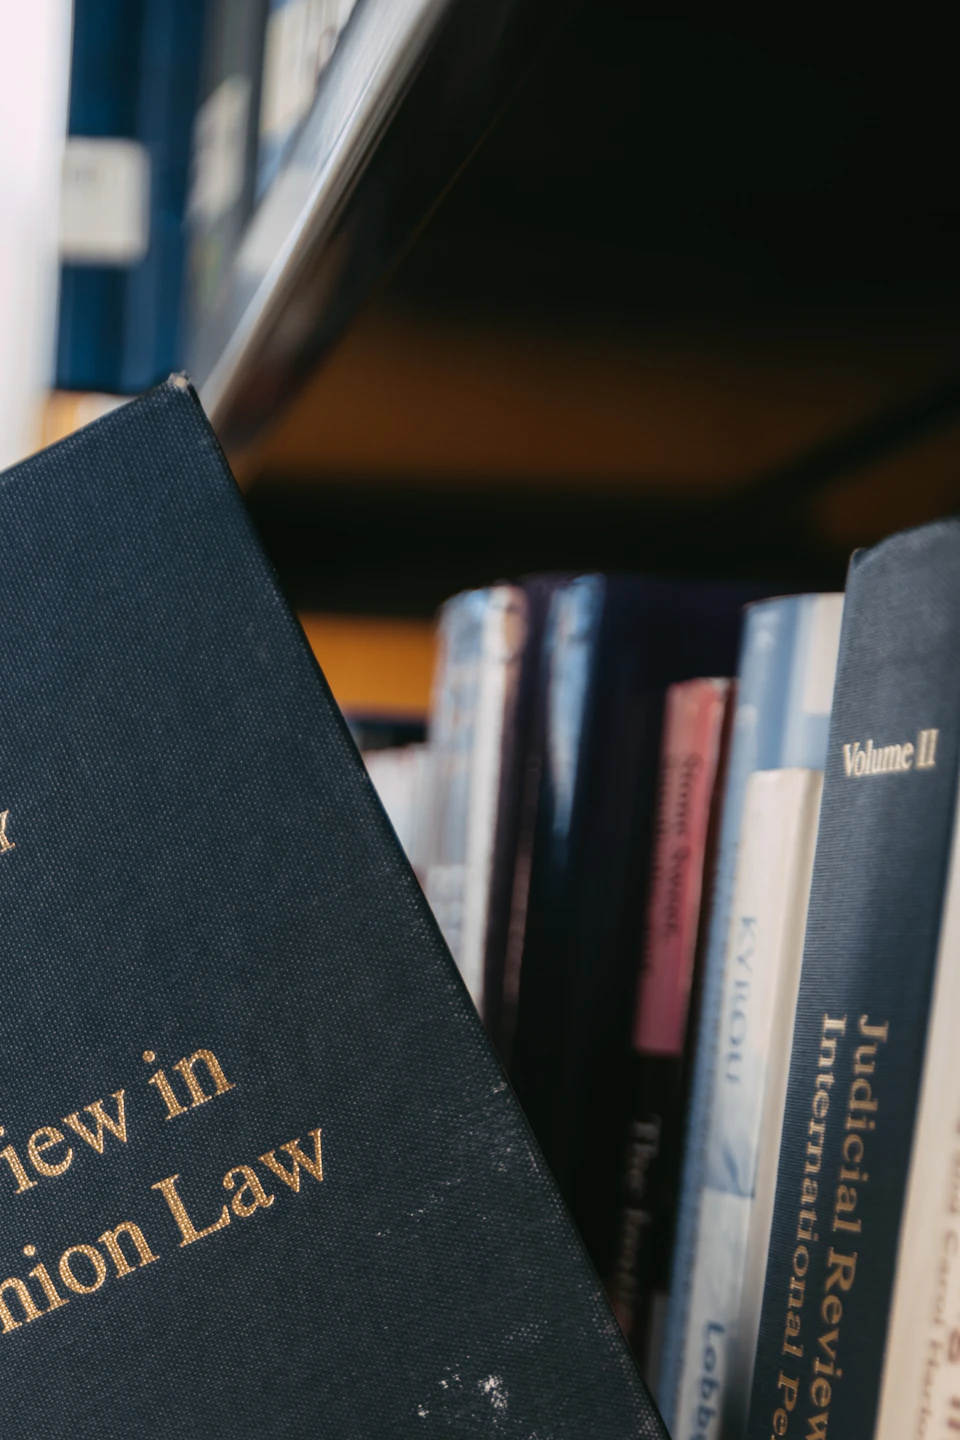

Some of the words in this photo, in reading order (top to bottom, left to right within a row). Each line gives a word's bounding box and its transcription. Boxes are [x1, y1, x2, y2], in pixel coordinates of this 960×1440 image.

[843, 739, 915, 777] Volume
[915, 728, 939, 769] II
[142, 1048, 236, 1121] in
[833, 1014, 888, 1232] Judicial
[150, 1127, 325, 1248] Law
[783, 1013, 846, 1357] International
